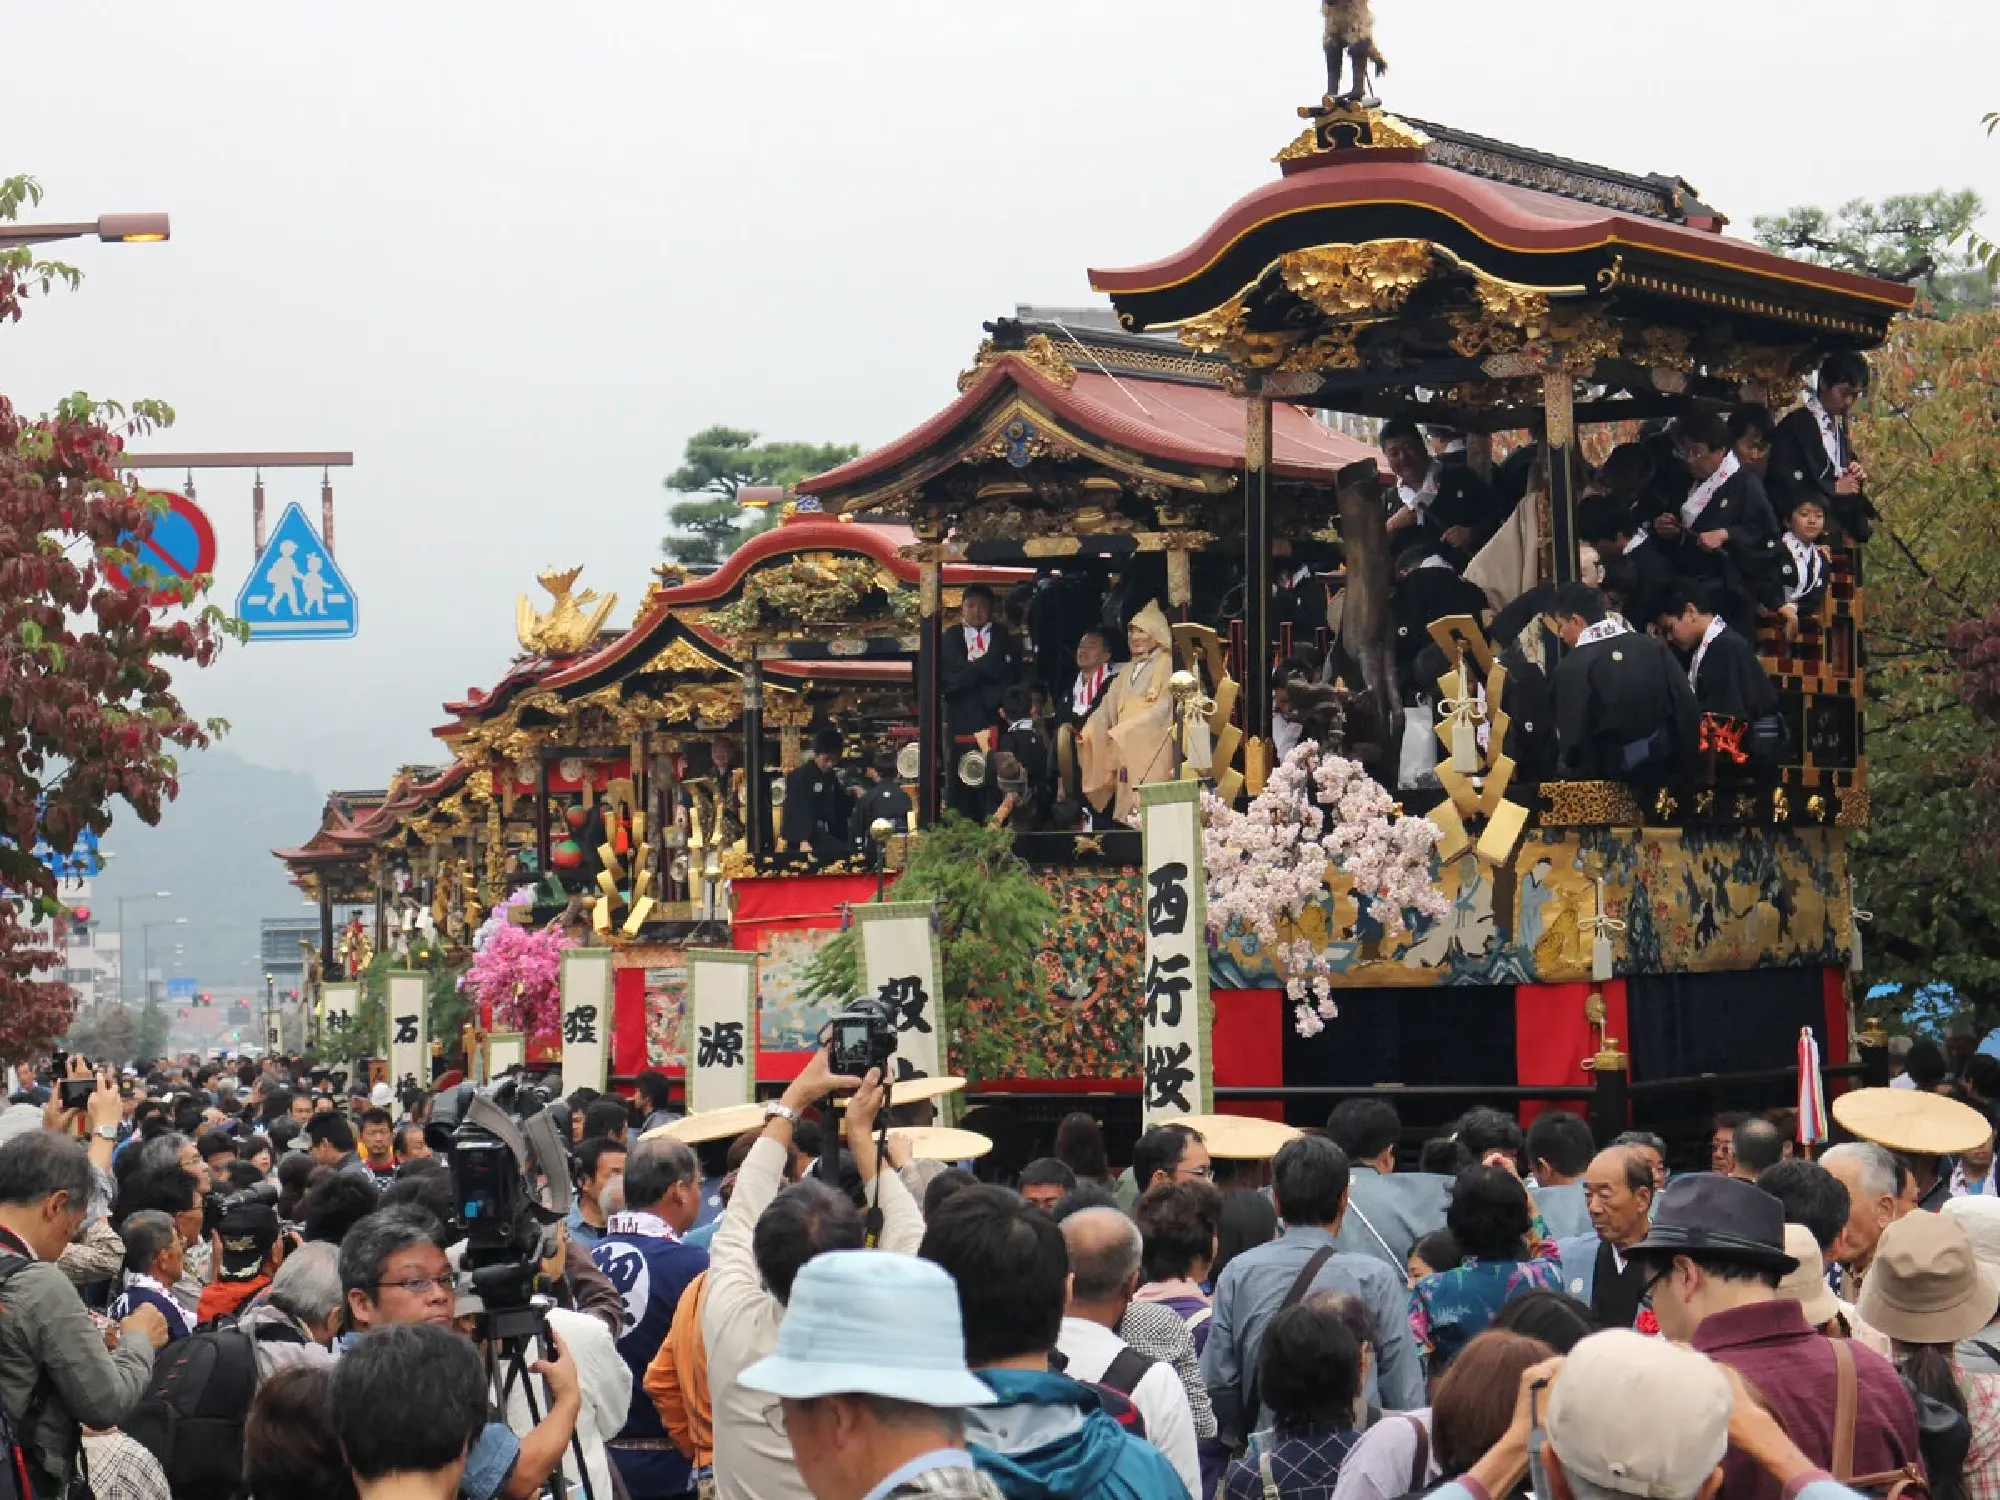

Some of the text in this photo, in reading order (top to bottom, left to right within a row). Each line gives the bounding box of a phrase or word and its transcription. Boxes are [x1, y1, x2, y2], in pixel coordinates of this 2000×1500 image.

[1146, 862, 1195, 1112] 西行桜
[564, 1004, 598, 1044] 猩
[697, 1021, 744, 1068] 源
